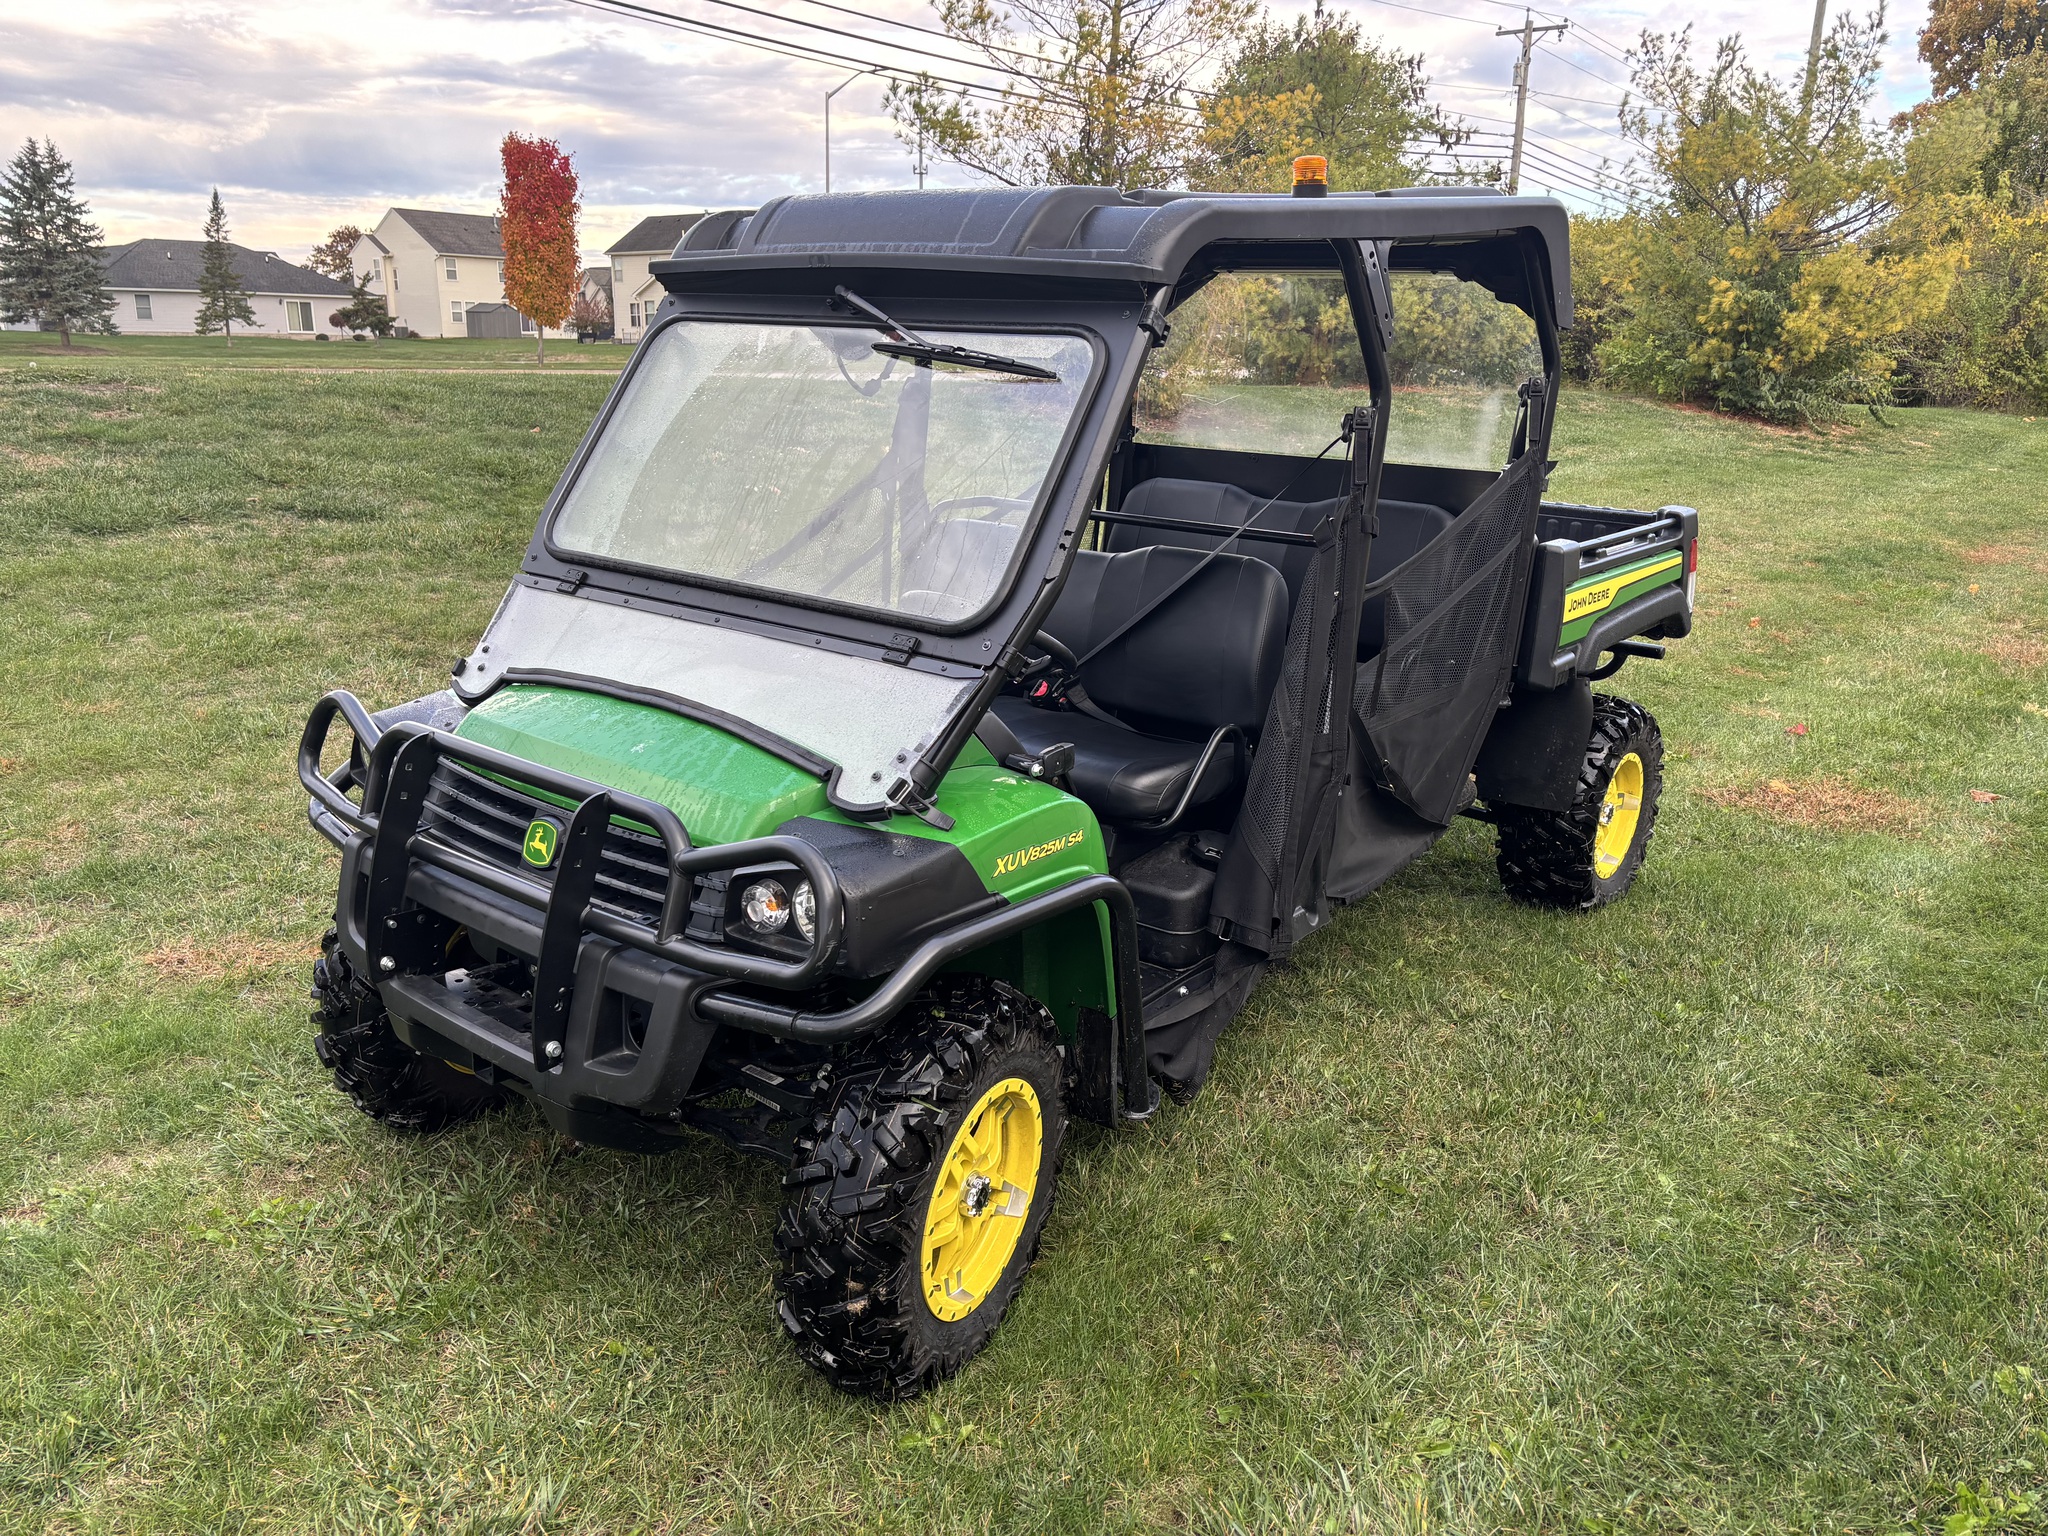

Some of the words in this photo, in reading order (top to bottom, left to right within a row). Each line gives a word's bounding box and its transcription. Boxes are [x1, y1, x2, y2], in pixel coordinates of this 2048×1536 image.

[1568, 596, 1587, 612] JOHN
[1588, 588, 1610, 605] DEERE
[991, 836, 1066, 879] XUV825M
[1067, 829, 1084, 847] S4
